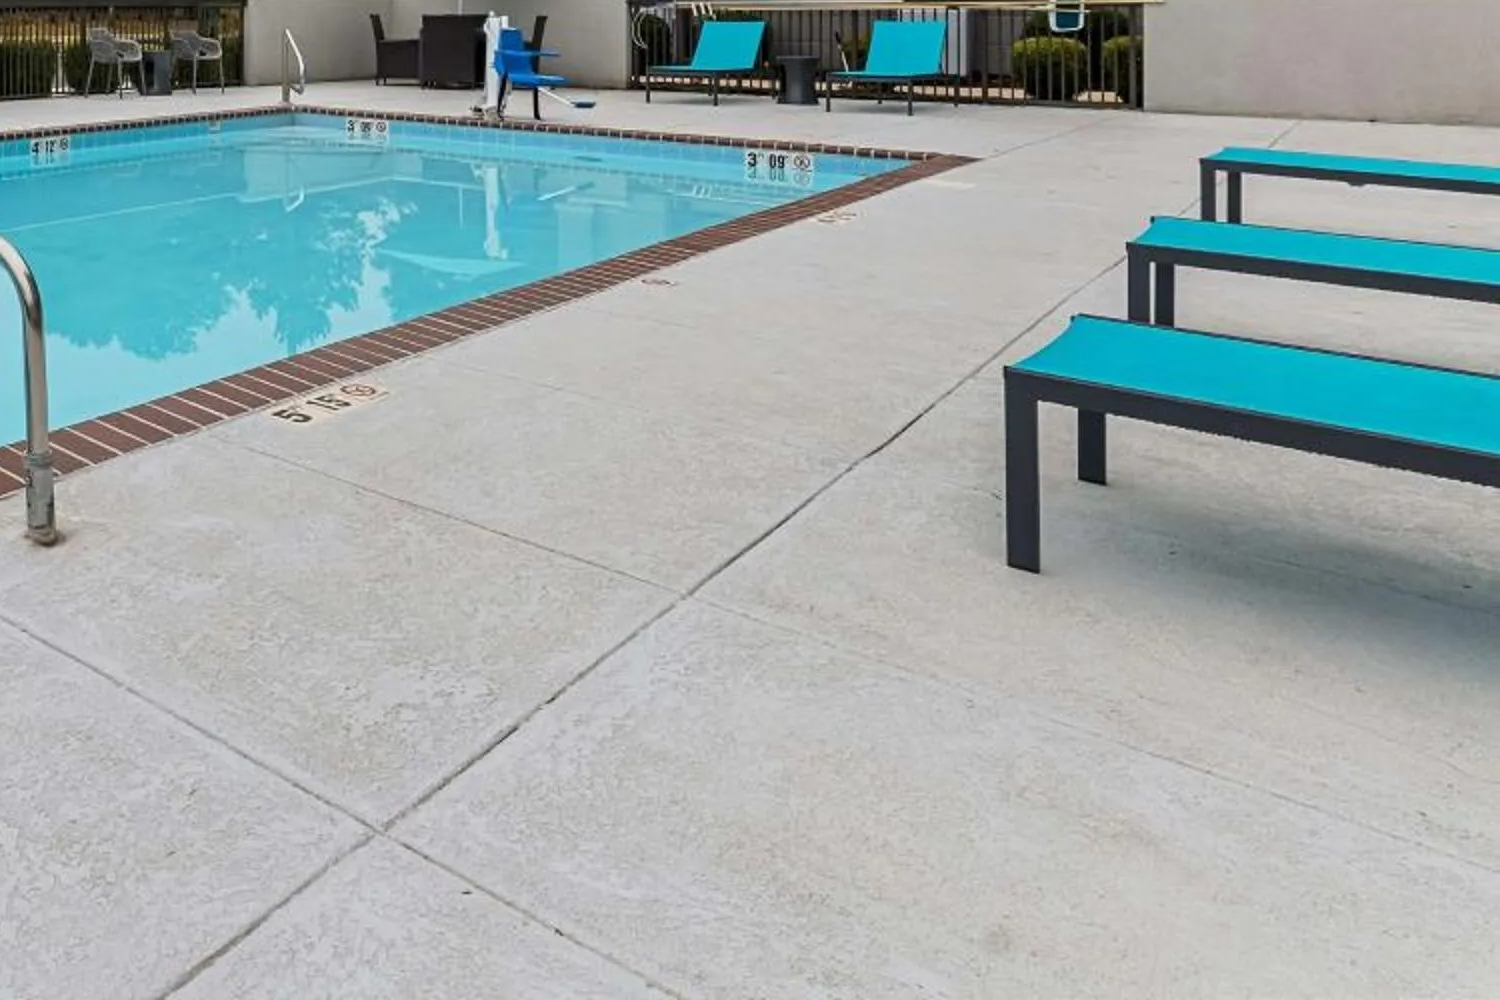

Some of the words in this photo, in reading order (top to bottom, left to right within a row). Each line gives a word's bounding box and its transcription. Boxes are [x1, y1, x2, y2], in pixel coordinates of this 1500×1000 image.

[31, 141, 39, 154] 4
[747, 151, 757, 167] 3
[272, 409, 314, 423] 5
